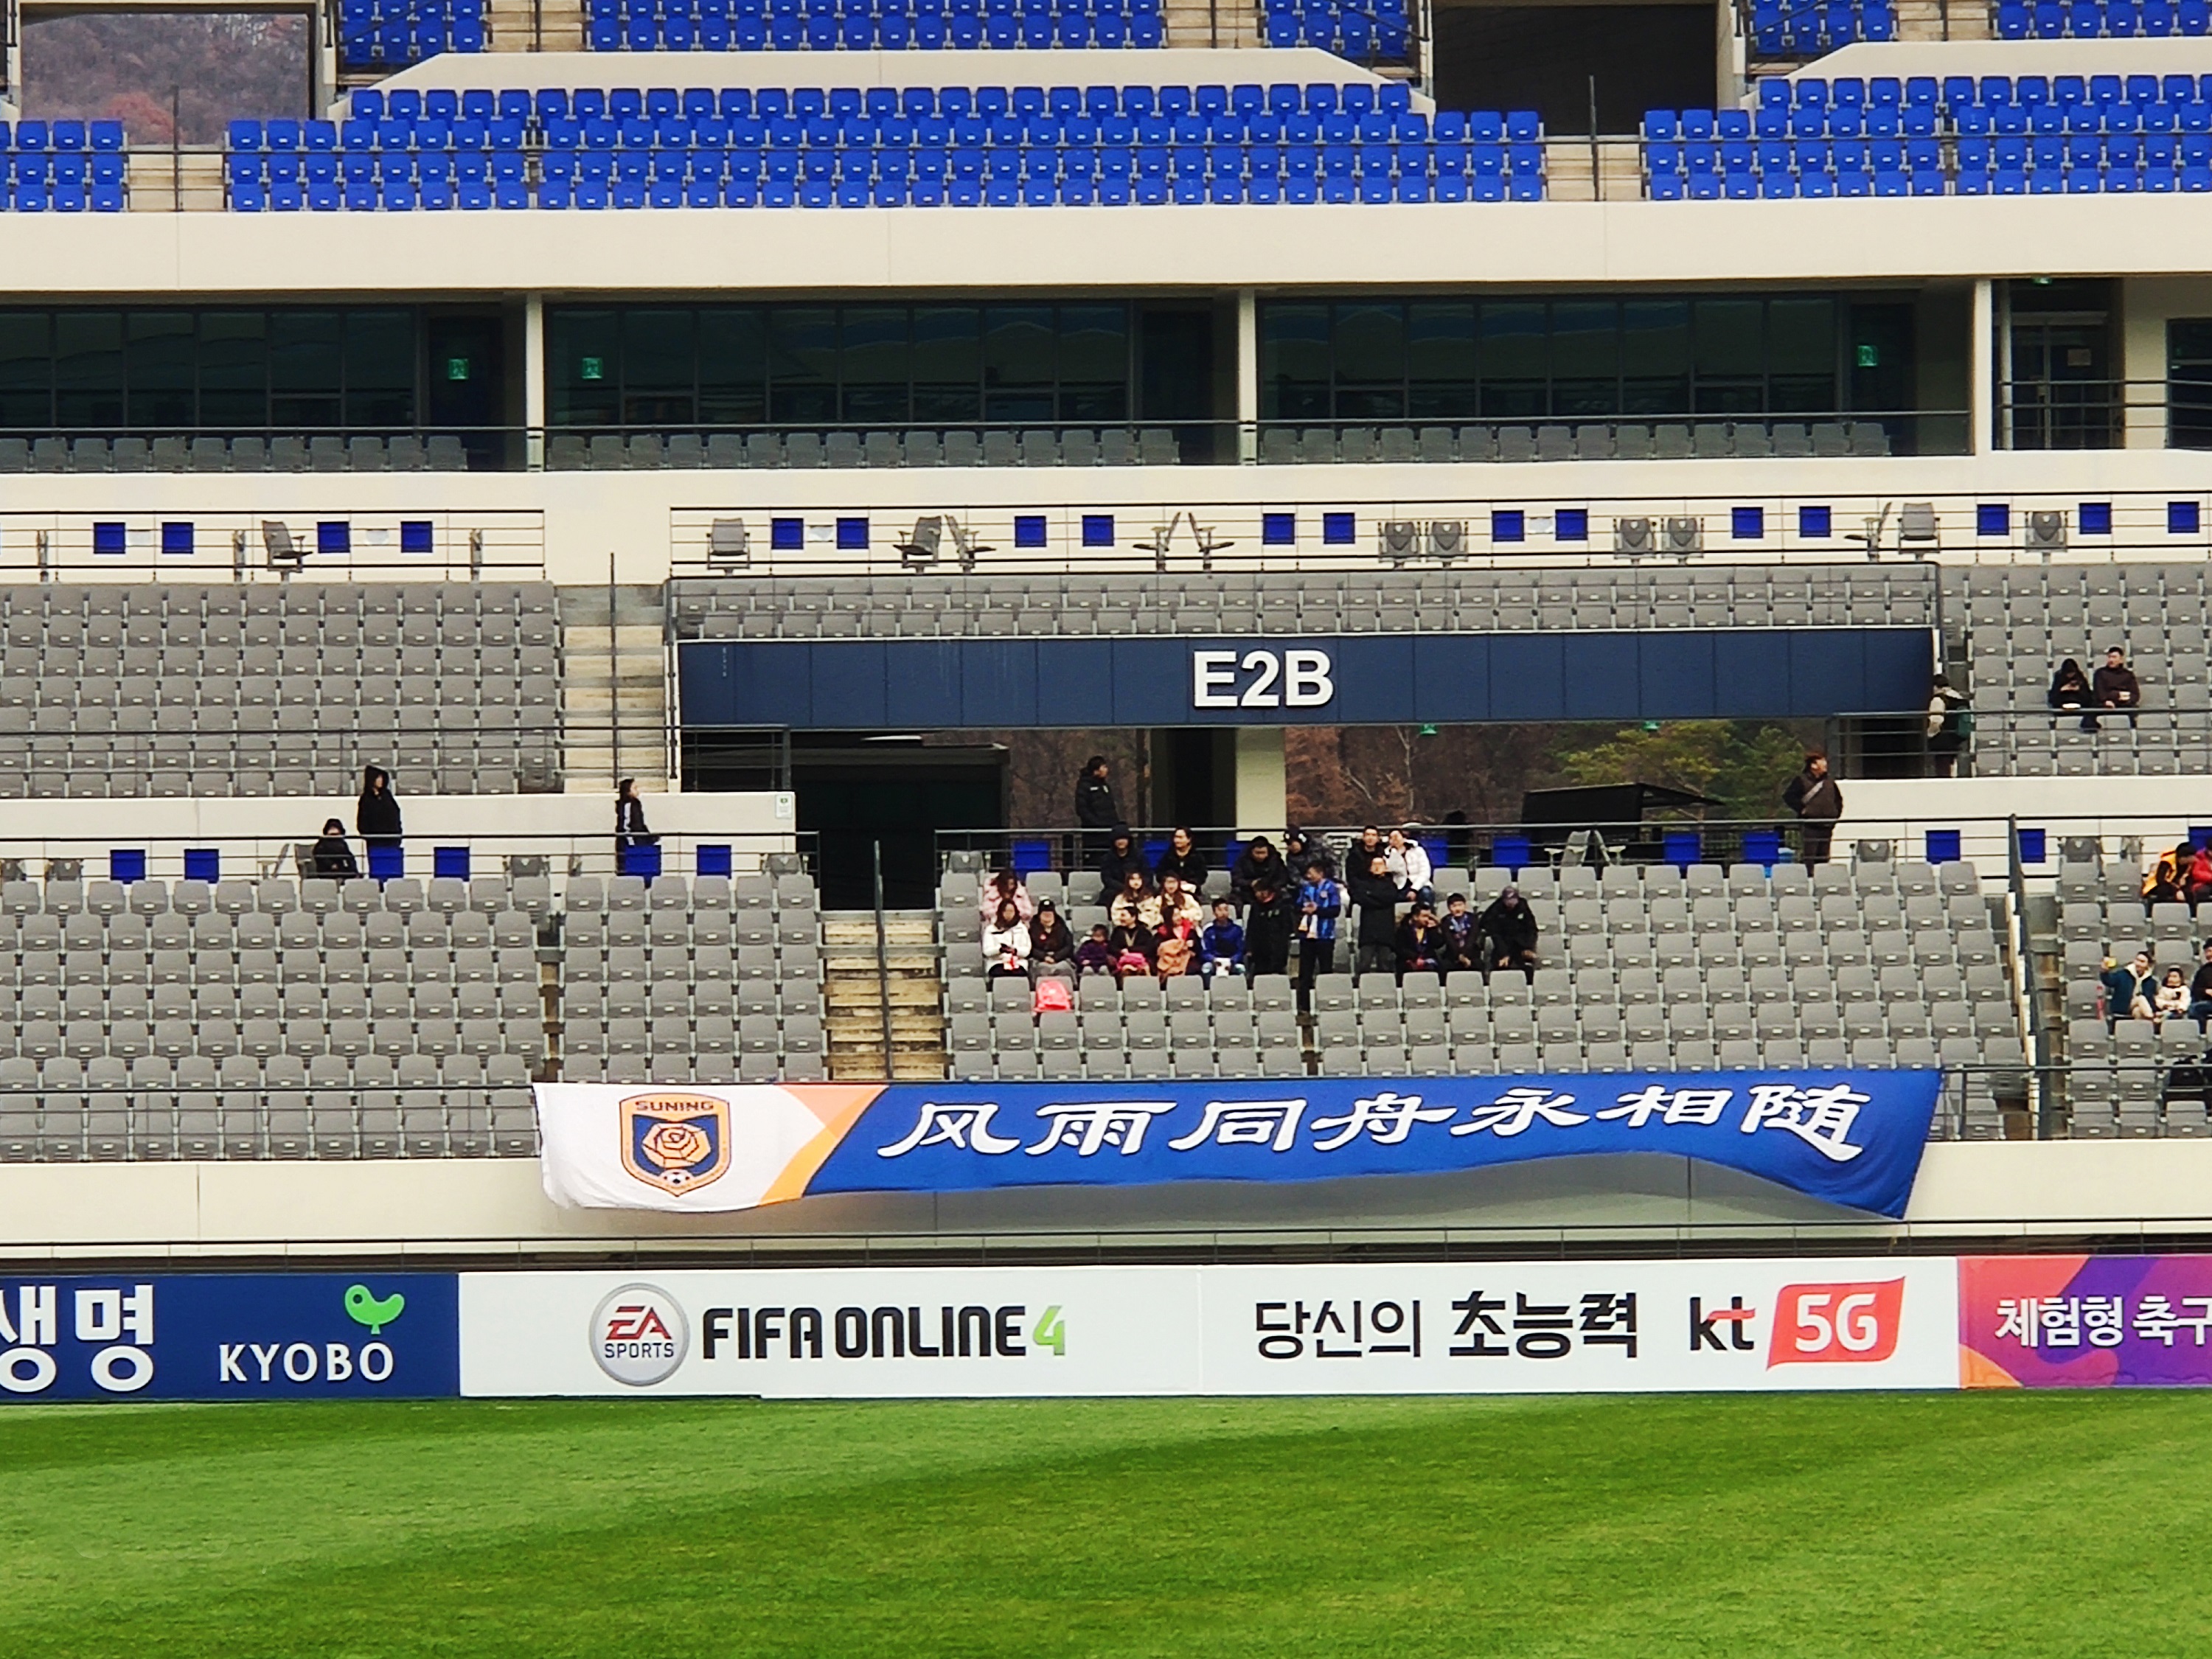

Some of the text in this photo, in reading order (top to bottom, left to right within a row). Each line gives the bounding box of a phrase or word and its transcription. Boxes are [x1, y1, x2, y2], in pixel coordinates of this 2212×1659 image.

[1194, 650, 1334, 707] E2B
[635, 1100, 714, 1112] SUNING
[877, 1085, 1871, 1161] 风雨同舟永相随
[606, 1307, 670, 1340] EA
[703, 1305, 1065, 1360] FIFA ONLINE 4
[1256, 1290, 1638, 1360] 당신의 초능력
[1689, 1295, 1756, 1352] kt
[1795, 1293, 1878, 1352] 5G
[1994, 1295, 2212, 1347] 체험형 축구
[219, 1342, 393, 1382] KYOBO
[605, 1342, 674, 1359] SPORTS
